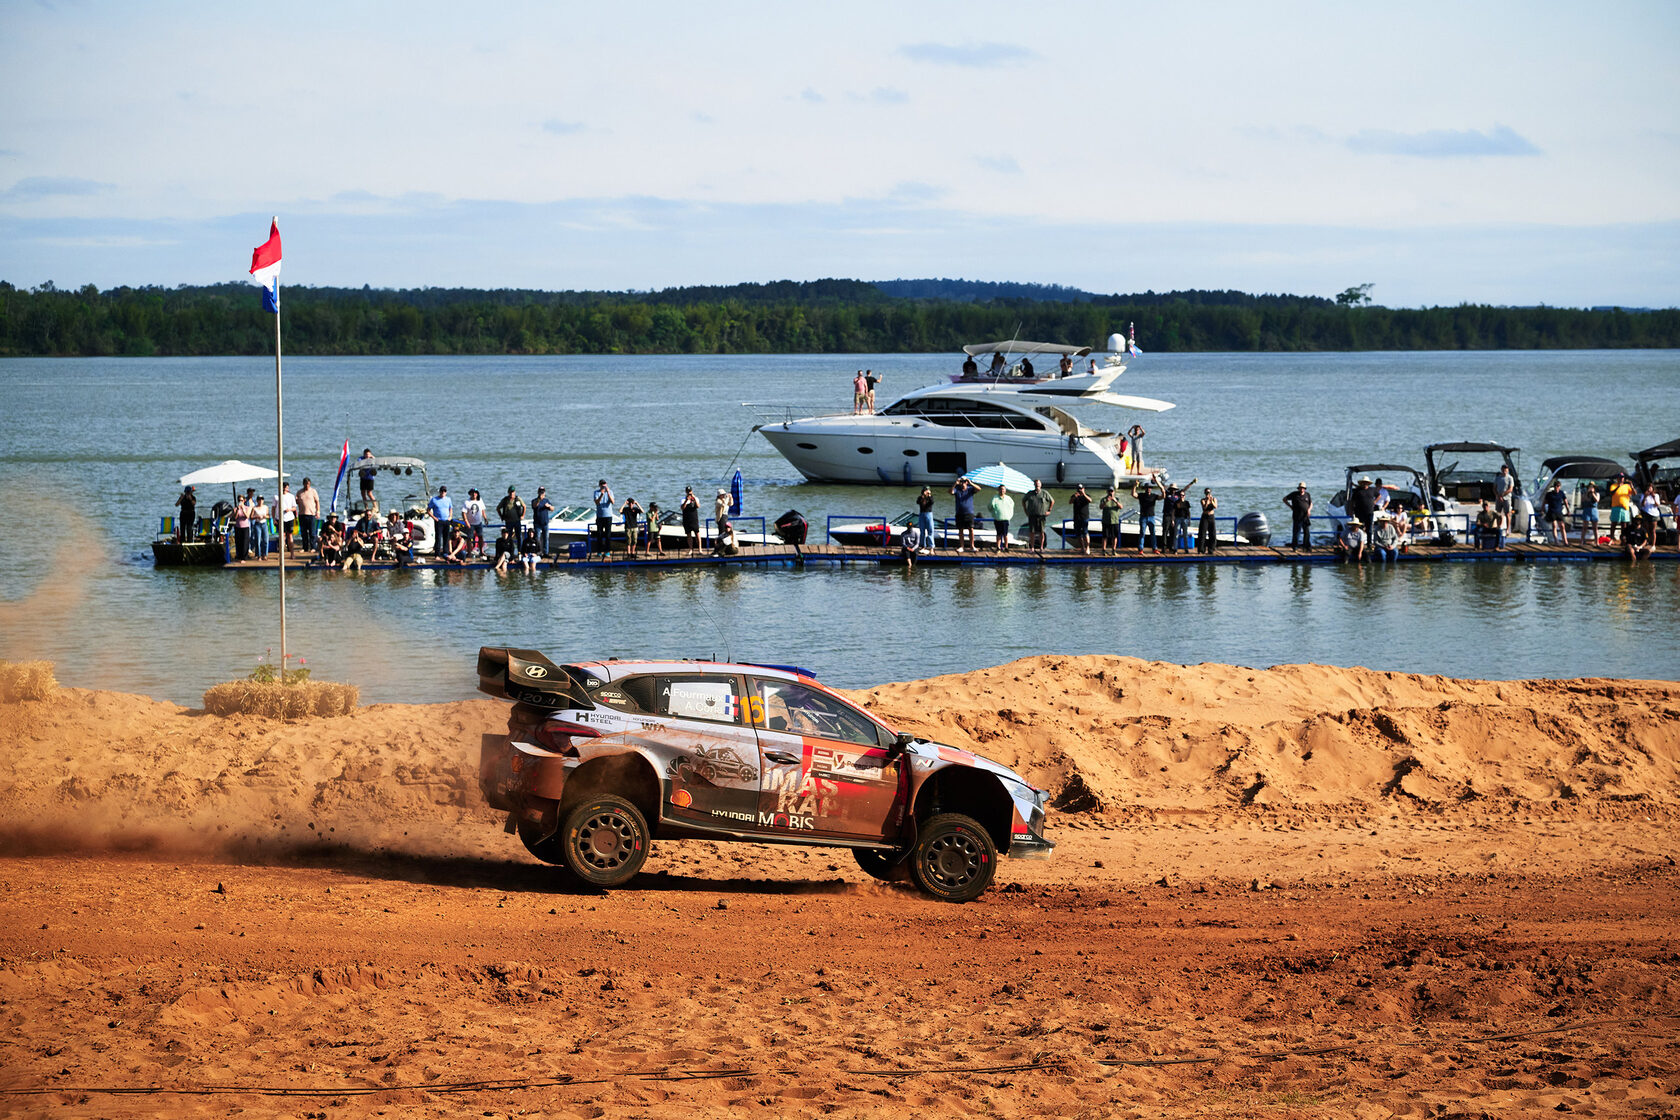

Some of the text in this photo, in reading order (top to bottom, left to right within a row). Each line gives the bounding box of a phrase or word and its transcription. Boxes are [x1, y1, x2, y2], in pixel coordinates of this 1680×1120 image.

[590, 713, 621, 721] HYUNDAI
[740, 695, 765, 724] 16
[711, 809, 755, 822] HYUNDAI
[757, 811, 815, 831] MOBIS
